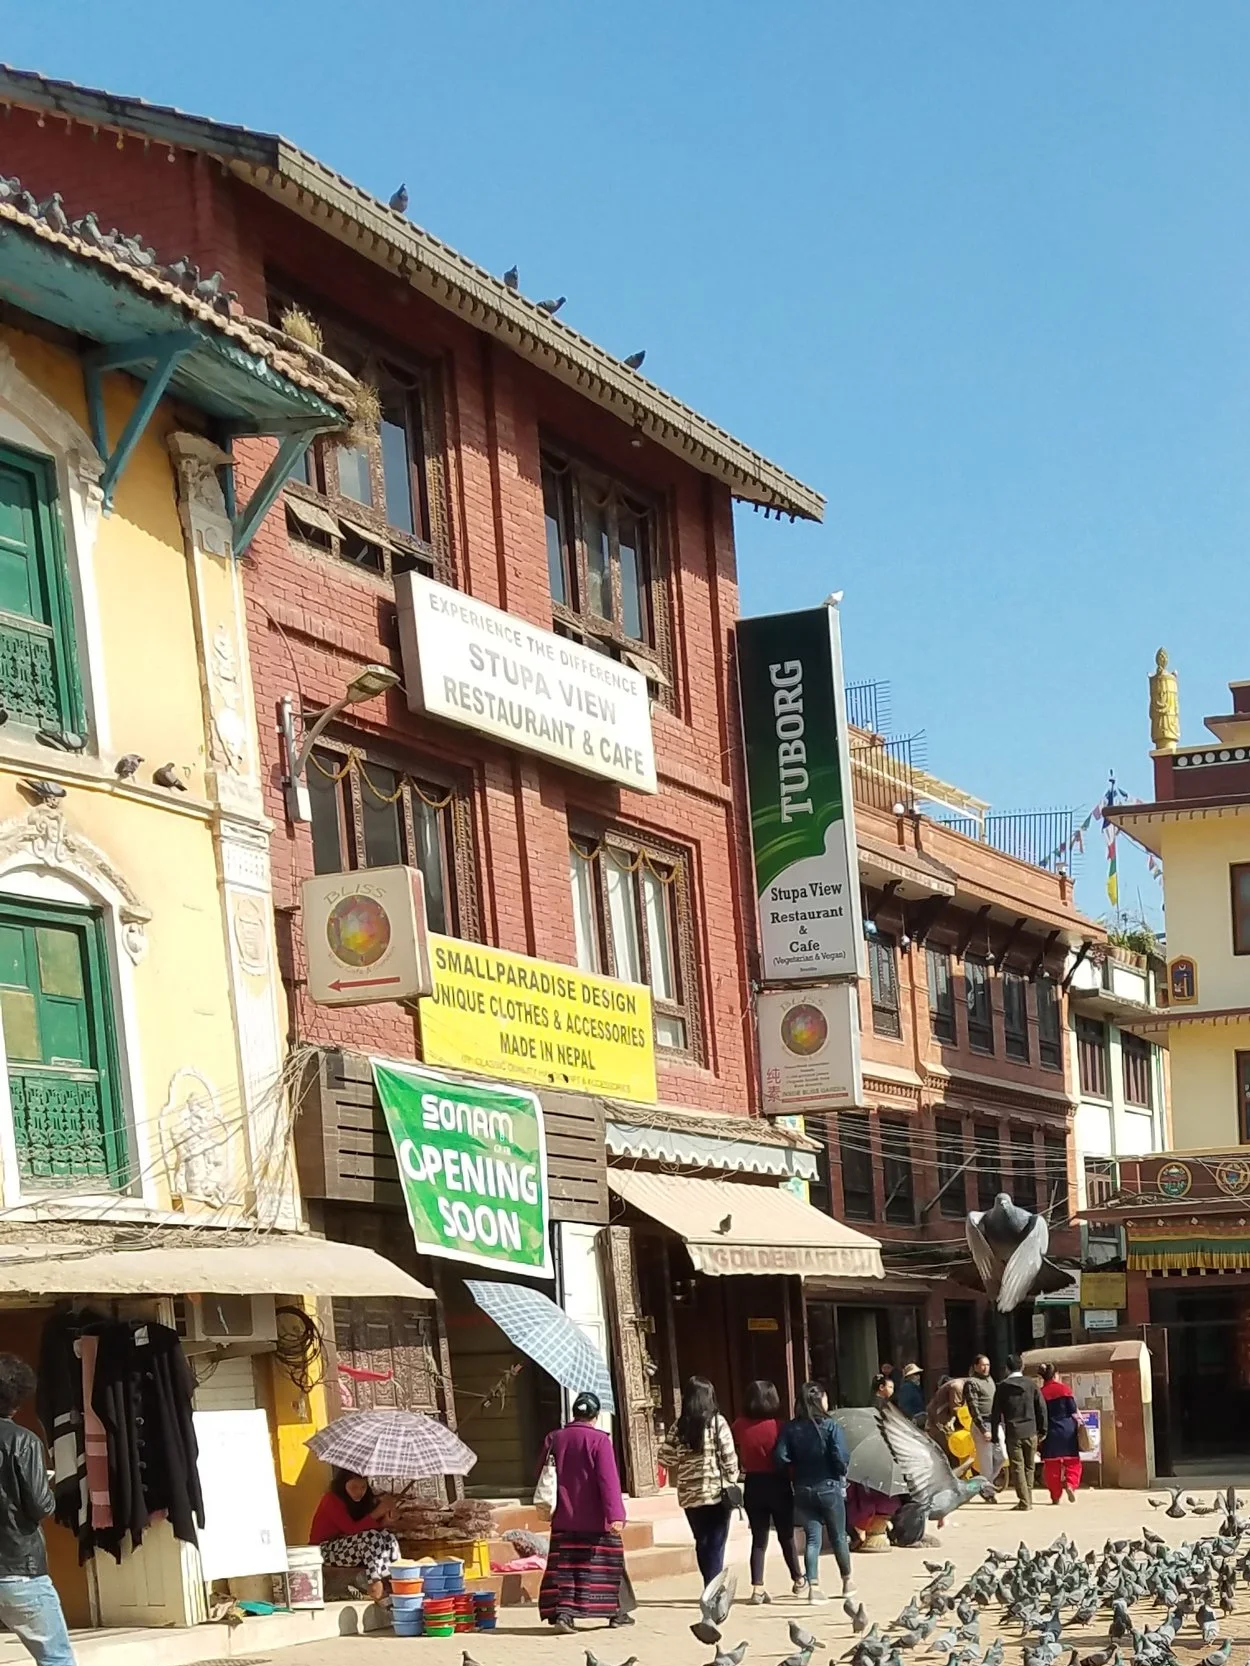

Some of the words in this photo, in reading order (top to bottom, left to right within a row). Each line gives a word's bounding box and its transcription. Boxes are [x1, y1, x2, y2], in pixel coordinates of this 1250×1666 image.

[428, 593, 523, 648] EXPERIENCE
[526, 636, 555, 661] THE
[560, 650, 638, 696] DIFFERENCE
[469, 643, 552, 700] STUPA
[558, 680, 617, 726] VIEW
[443, 675, 575, 750] RESTAURANT
[582, 730, 595, 757] &
[600, 737, 645, 777] CAFE
[768, 659, 815, 824] TUBORG
[324, 884, 387, 905] BLISS
[770, 906, 843, 924] Restaurant
[771, 887, 808, 903] Stupa
[809, 882, 842, 897] View
[789, 940, 820, 953] Cafe
[799, 925, 808, 935] &
[435, 948, 577, 1001] SMALLPARADISE
[582, 984, 637, 1015] DESIGN
[432, 982, 485, 1014] UNIQUE
[490, 996, 549, 1028] CLOTHES
[553, 1011, 562, 1030] &
[566, 1015, 645, 1048] ACCESSORIES
[500, 1032, 536, 1060] MADE
[540, 1040, 553, 1062] IN
[558, 1044, 596, 1070] NEPAL
[400, 1138, 538, 1205] OPENING
[439, 1196, 522, 1251] SOON
[715, 1249, 797, 1268] GOLDEN
